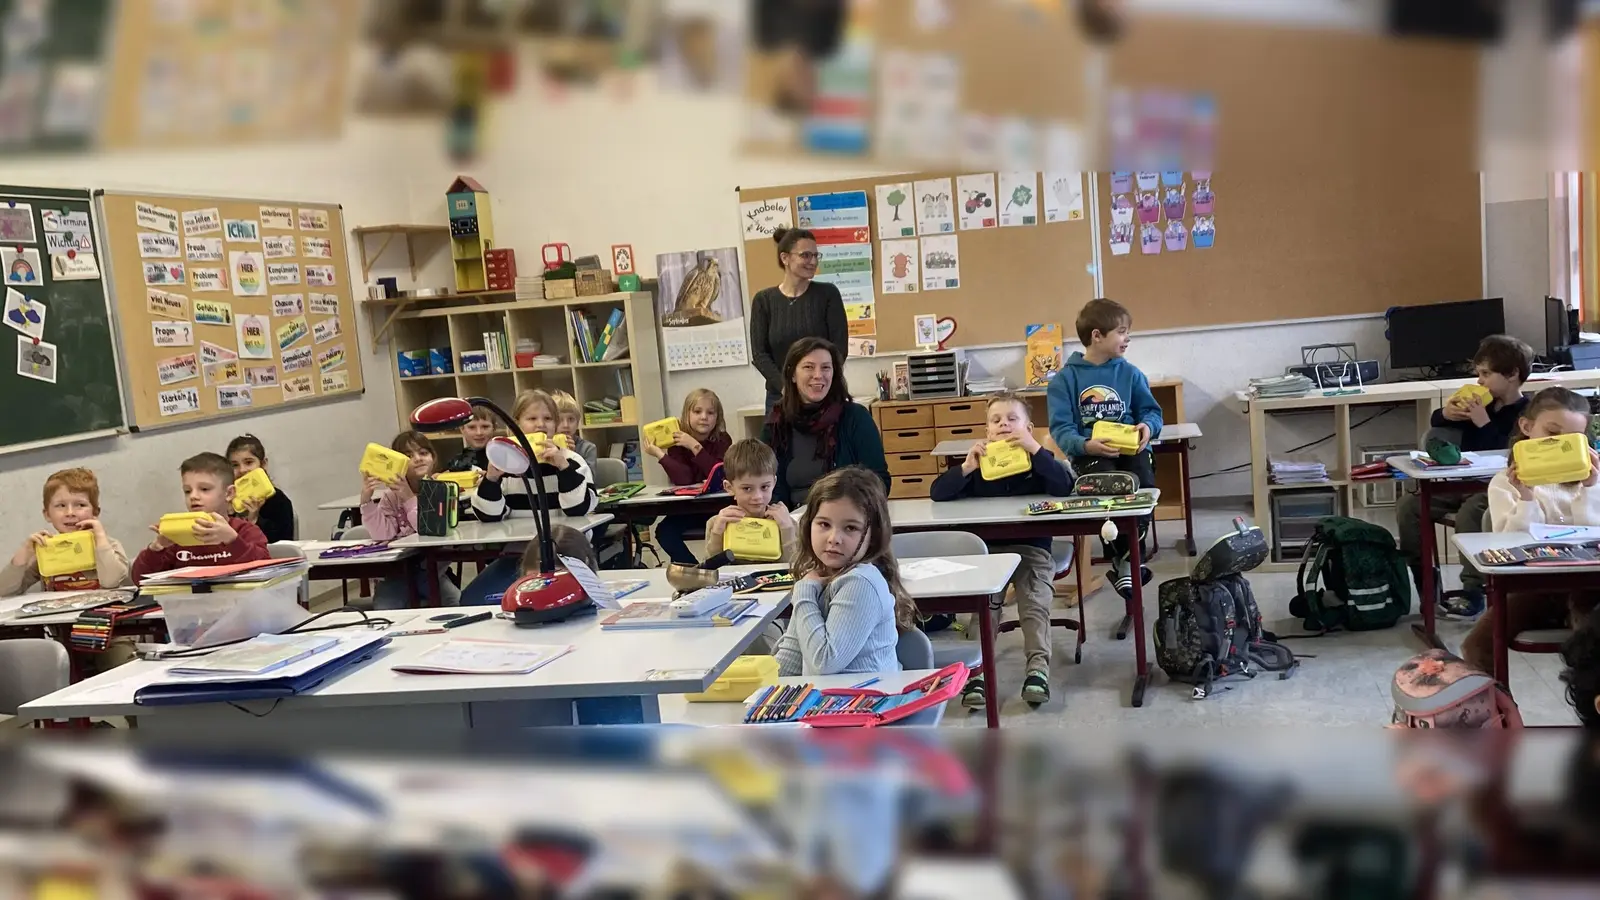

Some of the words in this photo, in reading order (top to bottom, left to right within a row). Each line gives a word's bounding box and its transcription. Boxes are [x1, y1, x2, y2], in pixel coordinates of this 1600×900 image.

[746, 203, 788, 220] Knobelei
[58, 214, 87, 227] Termine
[194, 215, 211, 224] Seiten
[227, 223, 244, 238] ICH
[944, 223, 950, 231] 2
[47, 235, 81, 250] Wichtig
[154, 237, 175, 246] wichtig
[187, 243, 206, 252] Freude
[241, 263, 254, 272] HIER
[193, 271, 218, 279] Probleme
[151, 295, 163, 304] viel
[164, 298, 181, 308] Neues
[274, 300, 294, 308] Chancen
[196, 303, 218, 312] Gefühle
[668, 317, 689, 326] September
[155, 327, 176, 336] Fragen
[246, 326, 260, 336] HIER
[203, 346, 216, 357] Hilfe
[1099, 403, 1123, 411] ISLANDS
